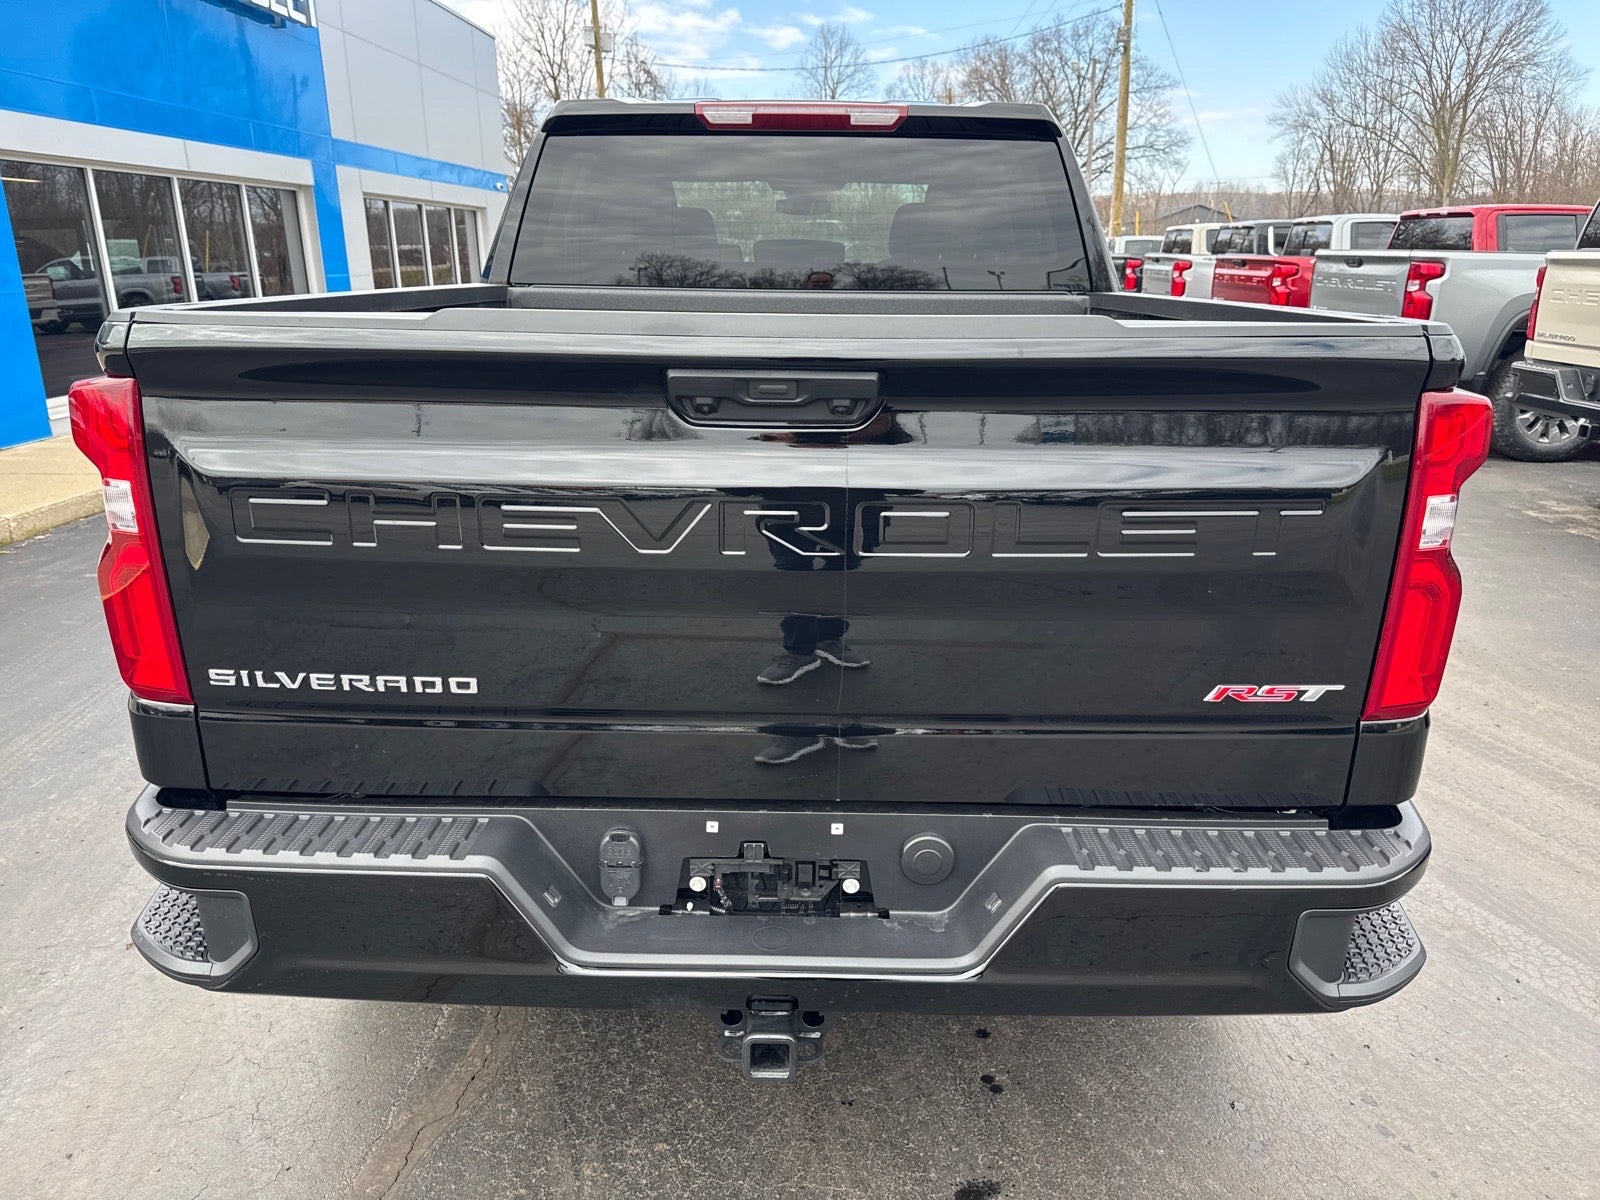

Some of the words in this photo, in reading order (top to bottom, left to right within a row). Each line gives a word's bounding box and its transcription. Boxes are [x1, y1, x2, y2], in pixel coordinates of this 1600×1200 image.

[230, 487, 1326, 559] CHEVROLET
[207, 668, 479, 695] SILVERADO
[1203, 683, 1346, 702] RST
